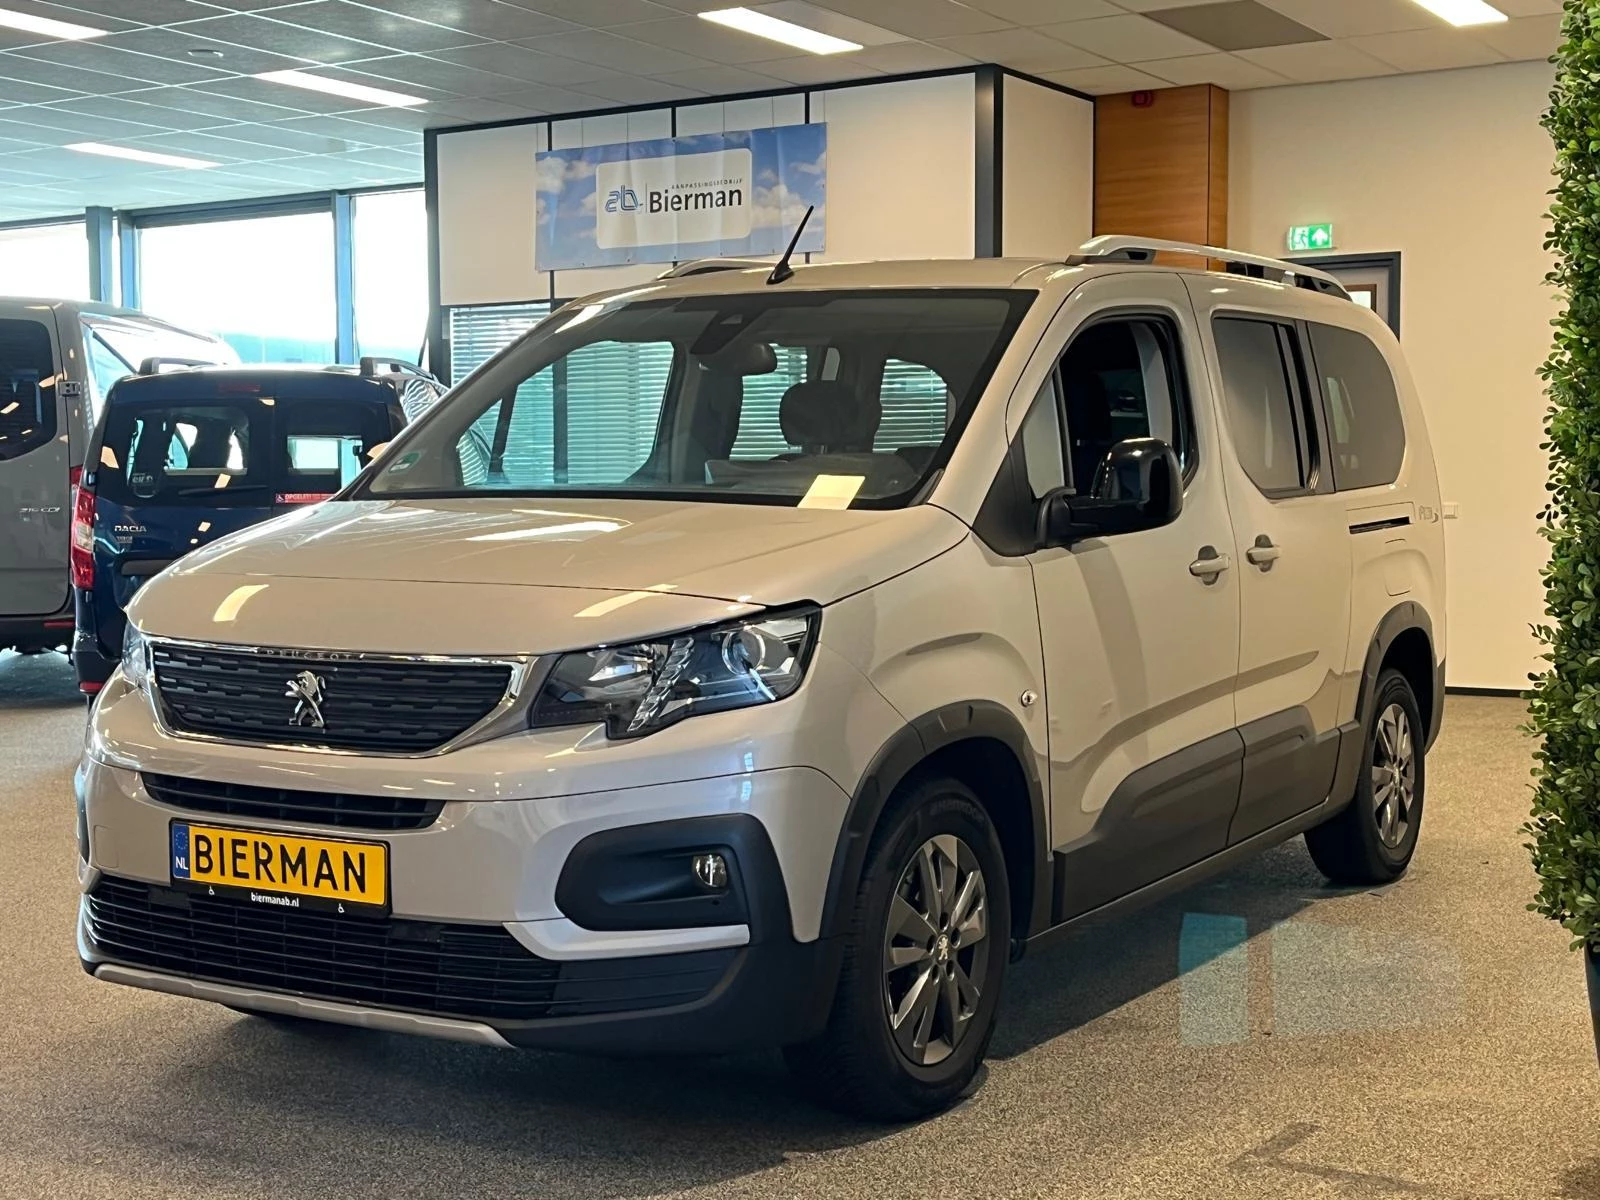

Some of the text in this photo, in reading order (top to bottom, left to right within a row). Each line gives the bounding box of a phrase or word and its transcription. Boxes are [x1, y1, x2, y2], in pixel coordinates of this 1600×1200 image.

[649, 188, 742, 214] Bierman
[266, 648, 353, 661] PEUGEOT
[175, 834, 366, 894] NL BIERMAN
[251, 891, 300, 908] biermanab.nl
